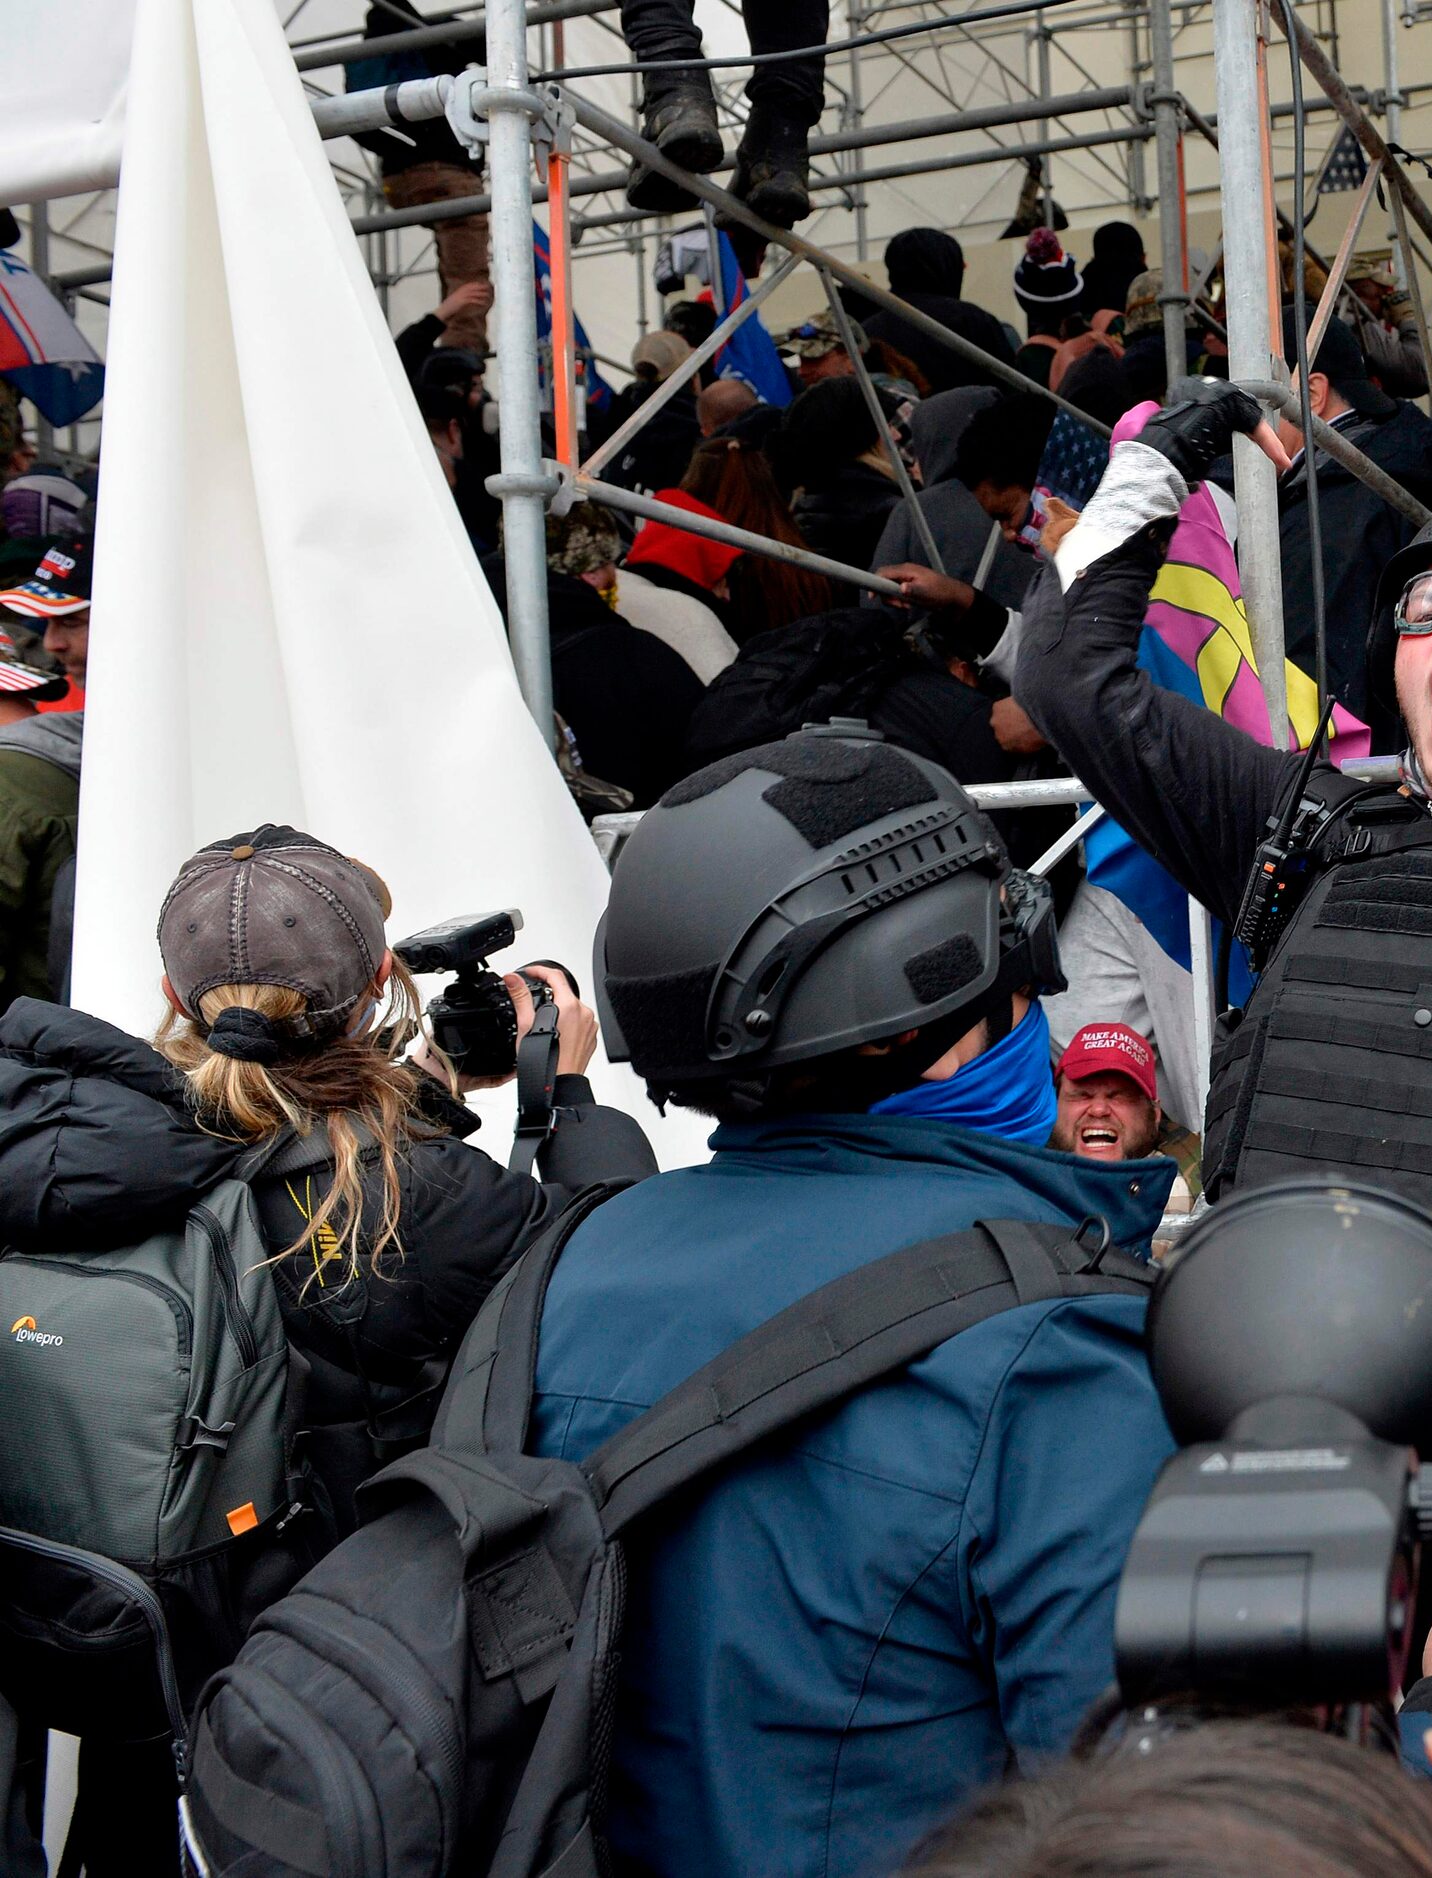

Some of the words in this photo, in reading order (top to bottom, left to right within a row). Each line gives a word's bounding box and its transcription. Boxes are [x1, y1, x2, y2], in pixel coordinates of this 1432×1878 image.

[1081, 1031, 1110, 1042] MAKE
[1110, 1031, 1149, 1062] AMERICA
[1084, 1039, 1117, 1050] GREAT
[1118, 1042, 1145, 1067] AGAIN
[15, 1327, 64, 1347] Lowepro
